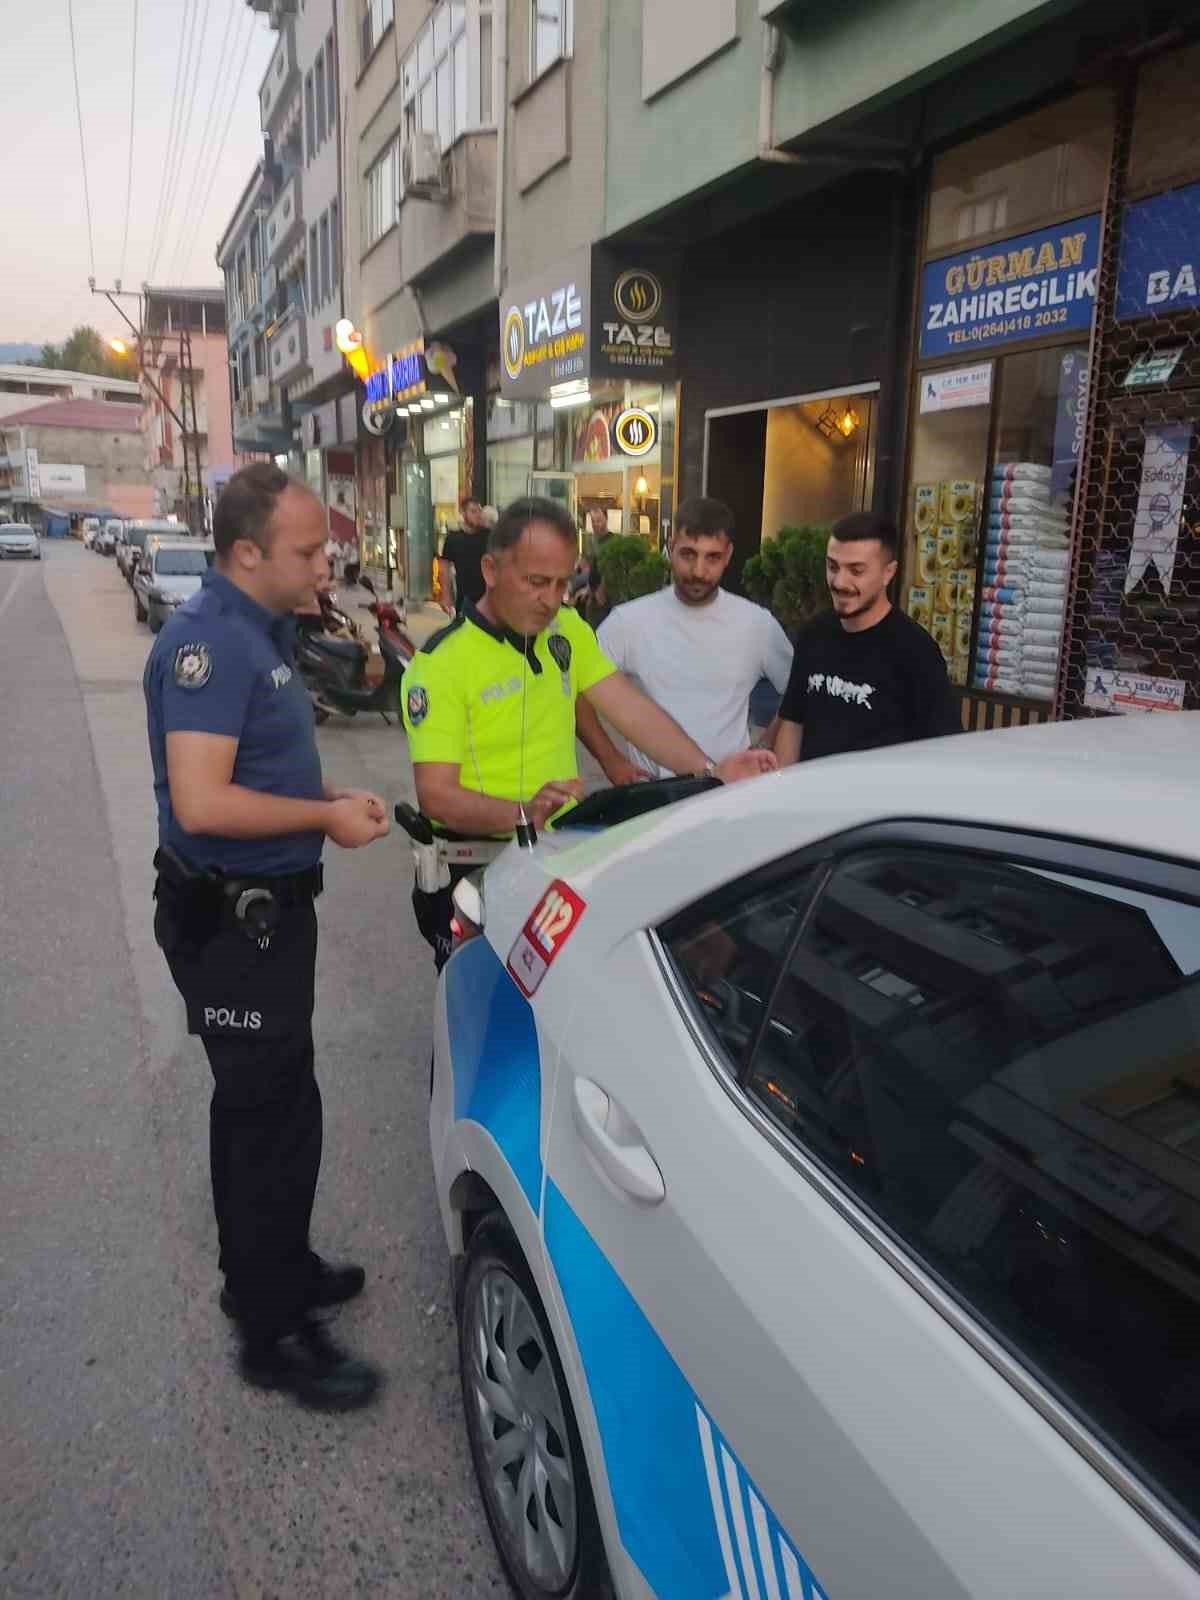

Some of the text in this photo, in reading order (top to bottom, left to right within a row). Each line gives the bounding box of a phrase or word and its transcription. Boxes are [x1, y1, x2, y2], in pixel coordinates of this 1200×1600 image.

[945, 233, 1087, 294] GÜRMAN
[525, 282, 582, 345] TAZE
[602, 322, 671, 347] TAZE
[1034, 307, 1067, 328] 2032
[530, 889, 573, 954] 112
[204, 1007, 262, 1029] POLIS
